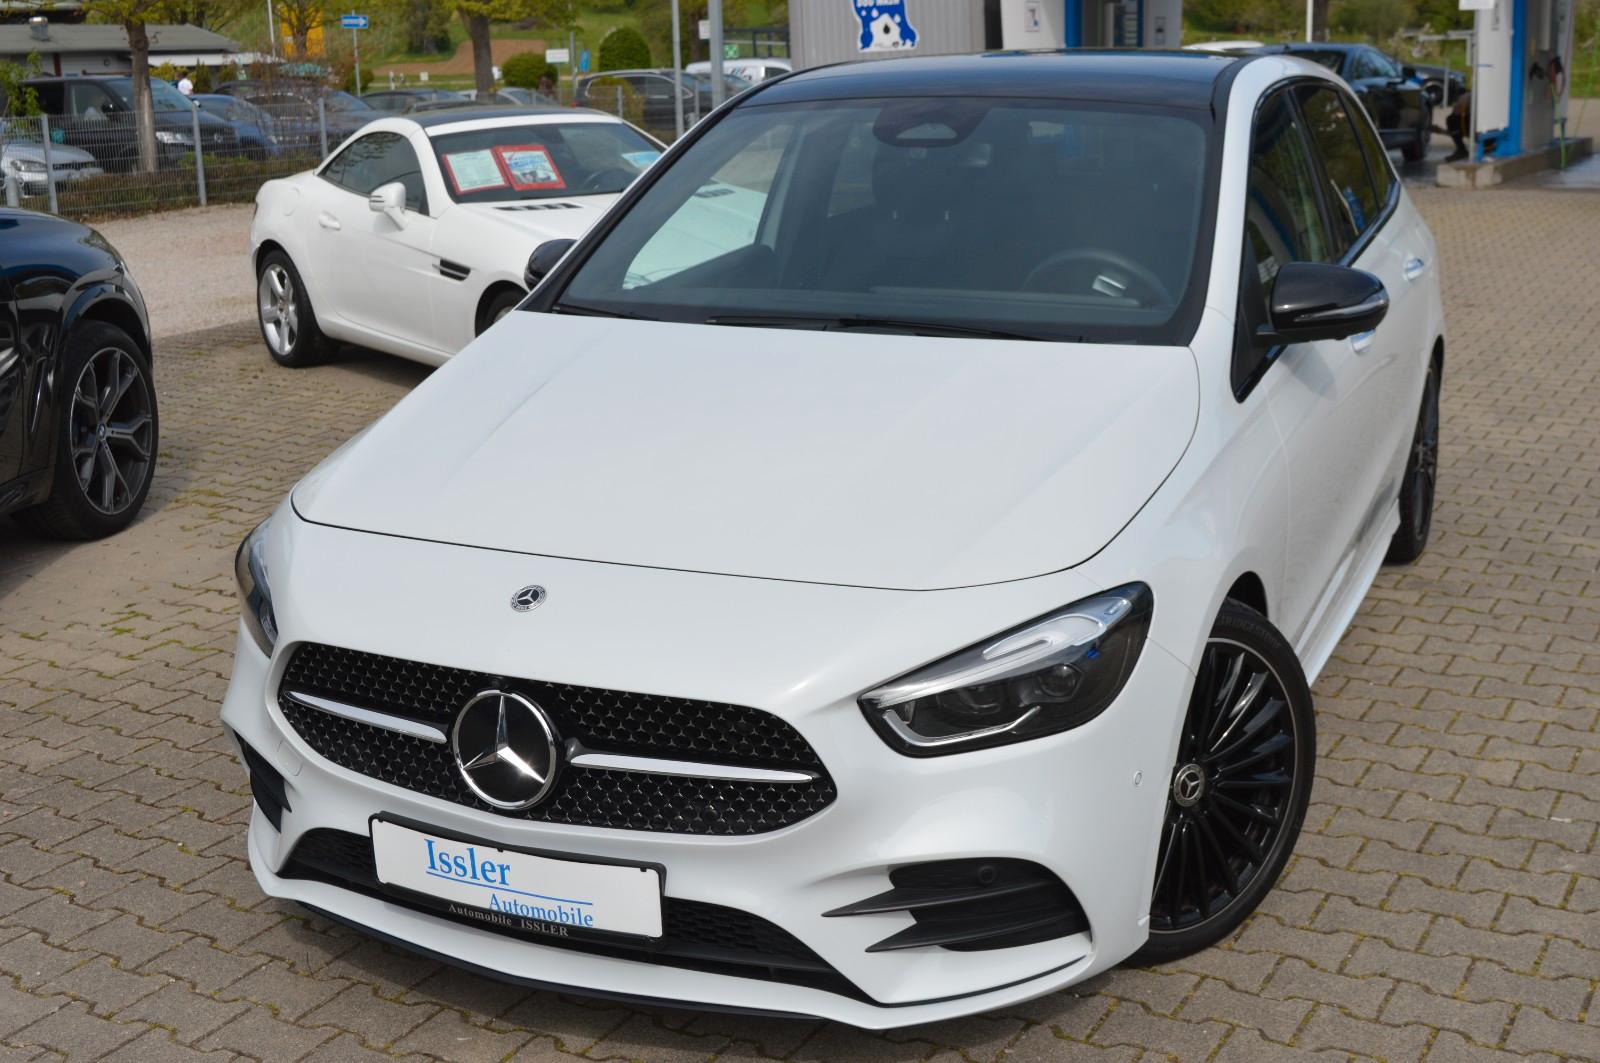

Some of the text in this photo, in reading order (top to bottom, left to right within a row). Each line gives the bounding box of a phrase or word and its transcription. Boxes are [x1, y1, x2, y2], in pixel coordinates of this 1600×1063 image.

[424, 838, 511, 886] Issler
[449, 904, 569, 937] Automobile ISSLER
[489, 893, 594, 927] Automobile
